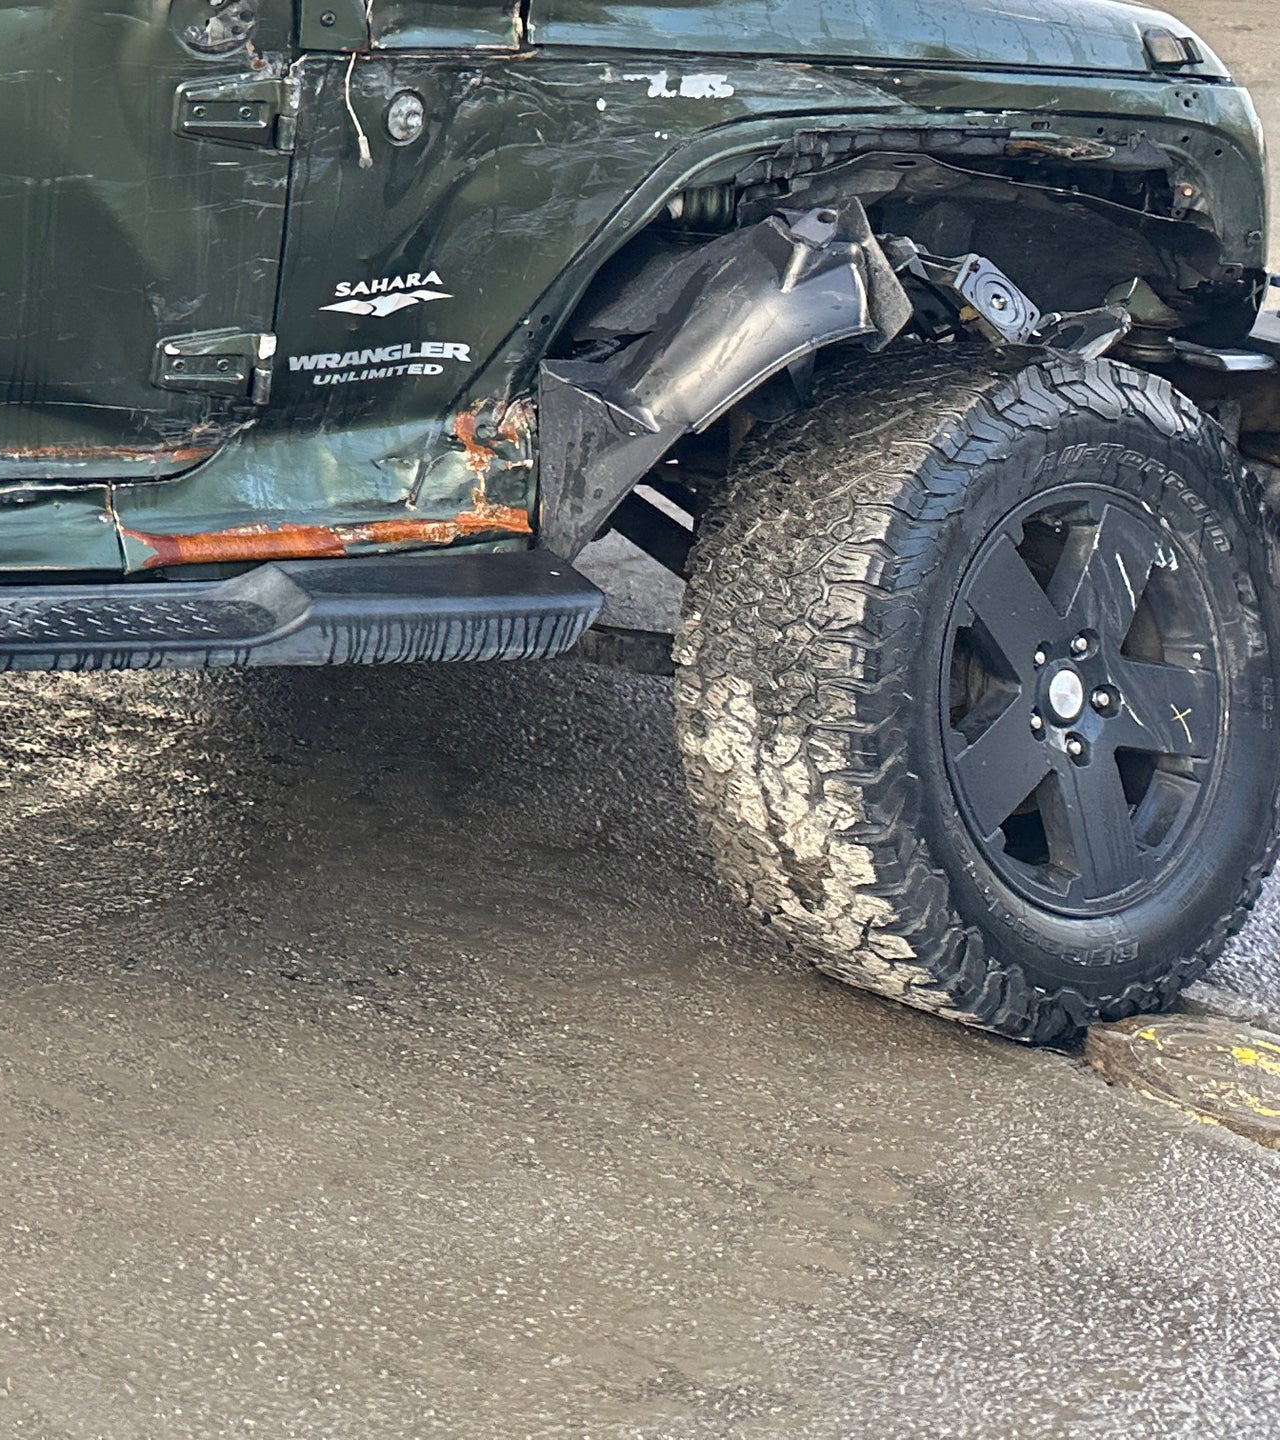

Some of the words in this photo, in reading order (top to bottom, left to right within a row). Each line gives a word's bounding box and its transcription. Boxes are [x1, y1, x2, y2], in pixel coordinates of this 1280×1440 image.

[334, 269, 444, 297] SAHARA
[288, 341, 472, 372] WRANGLER
[312, 363, 444, 386] UNLIMITED
